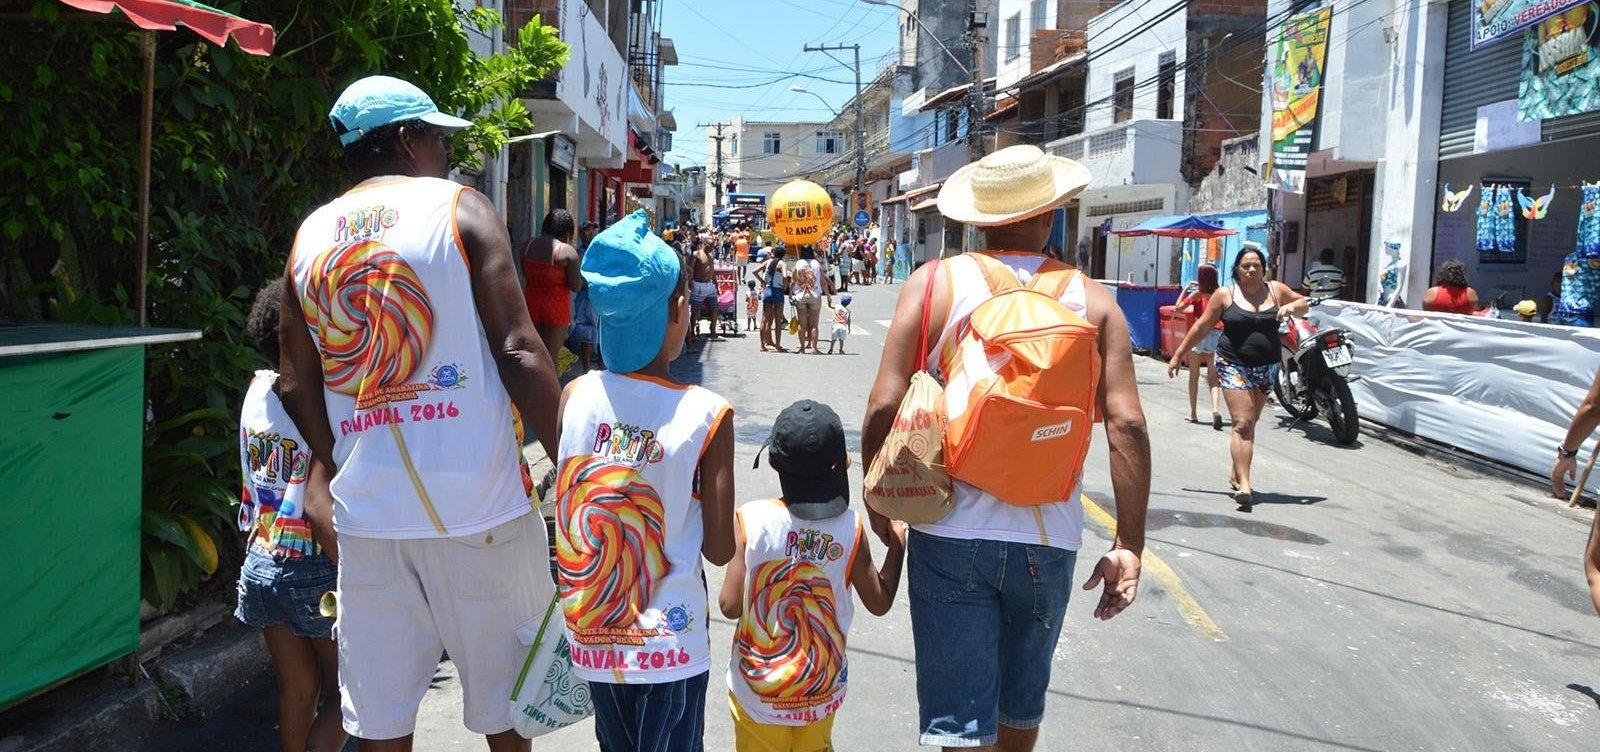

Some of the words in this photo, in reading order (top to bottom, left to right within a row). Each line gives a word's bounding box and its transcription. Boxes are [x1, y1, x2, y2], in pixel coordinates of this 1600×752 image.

[1514, 0, 1571, 25] VEREADO
[785, 227, 794, 236] 12
[795, 225, 818, 236] ANOS
[411, 401, 459, 422] 2016
[593, 422, 665, 464] PIRULITO
[1036, 424, 1069, 438] SCHIN
[785, 531, 844, 561] PIRULITO
[571, 646, 629, 670] NAVAL
[637, 646, 690, 670] 2016
